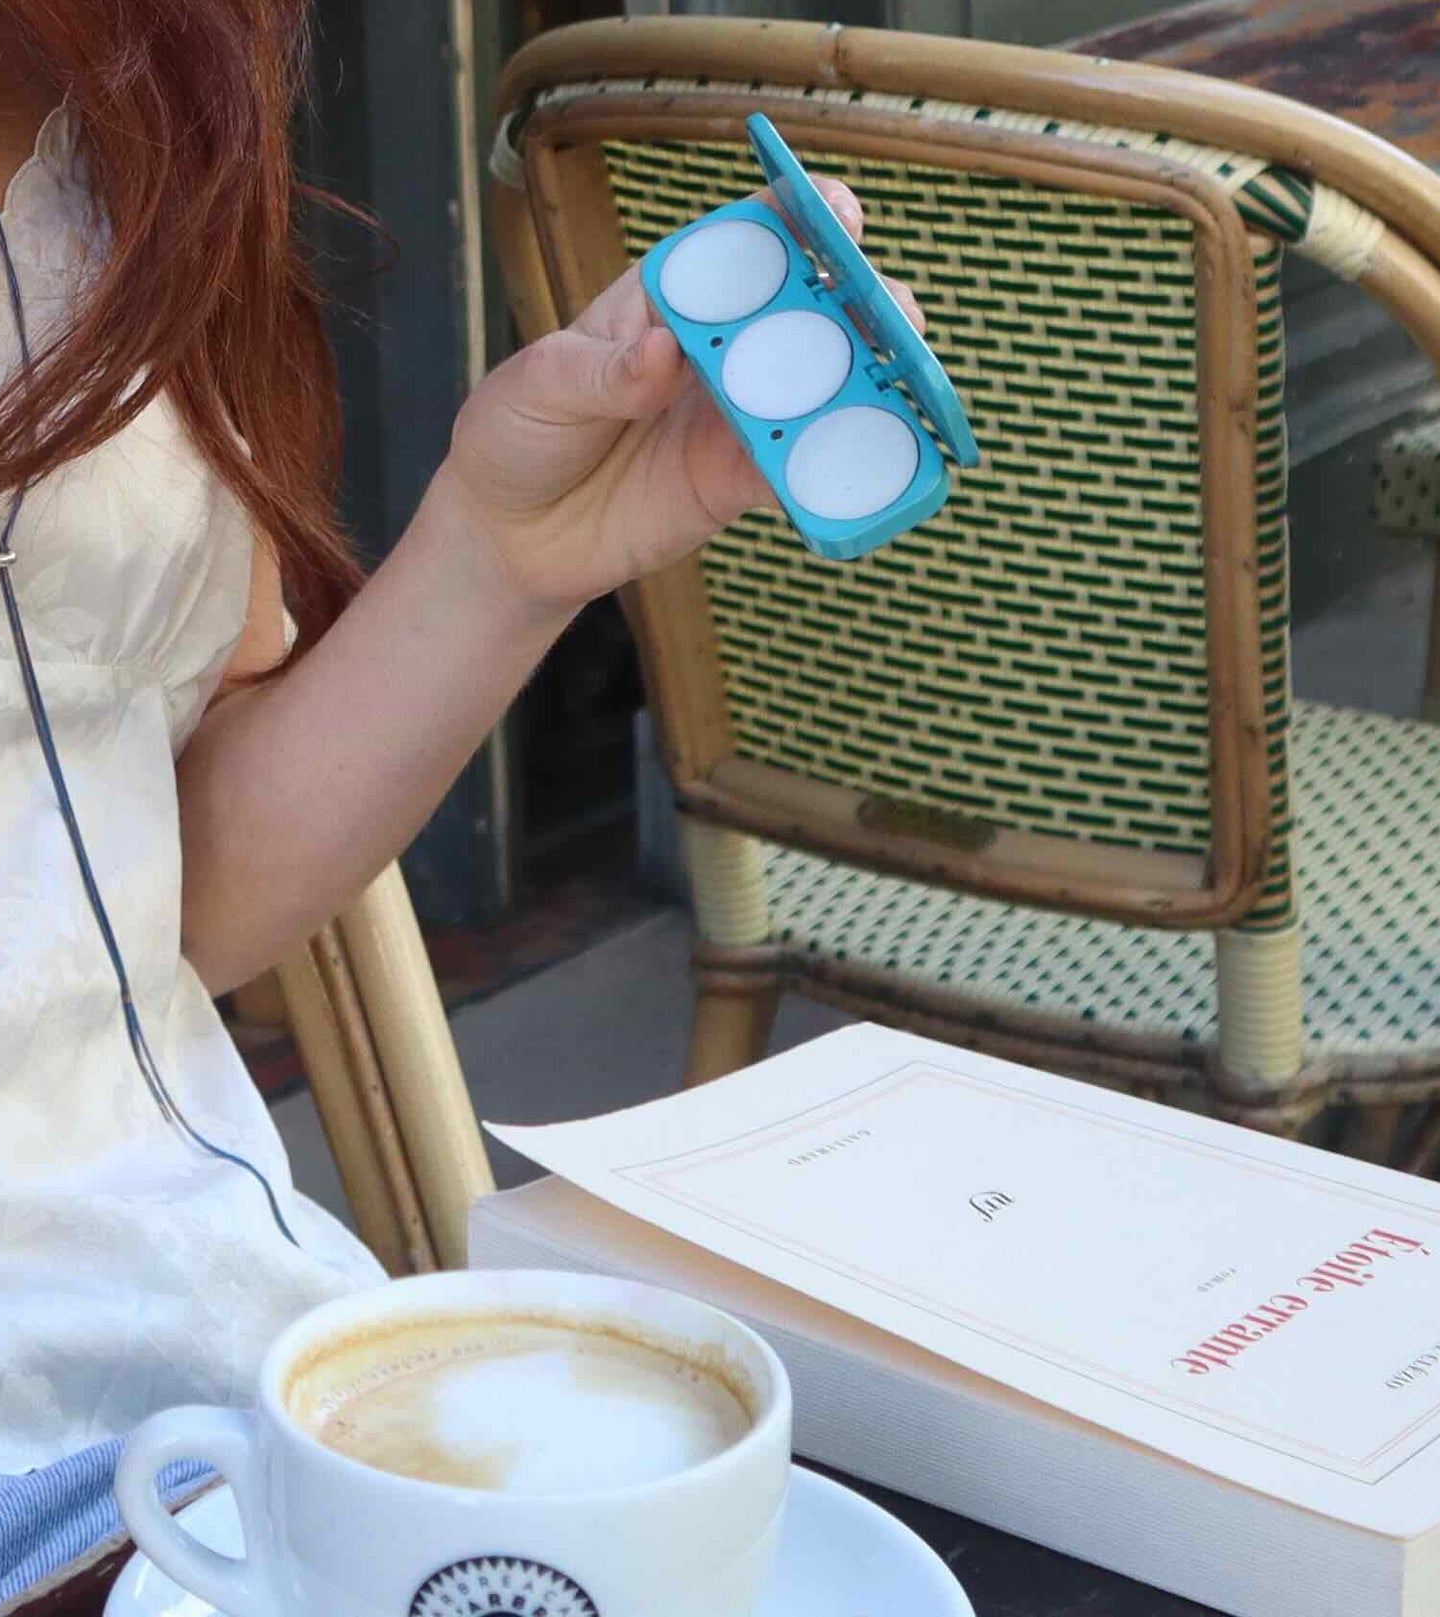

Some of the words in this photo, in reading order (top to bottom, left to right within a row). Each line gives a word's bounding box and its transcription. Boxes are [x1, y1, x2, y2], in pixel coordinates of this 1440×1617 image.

[969, 1191, 1014, 1223] nrf
[1296, 1228, 1431, 1293] Étoile
[1170, 1293, 1309, 1375] errante
[1384, 1354, 1438, 1389] CLÉZIO
